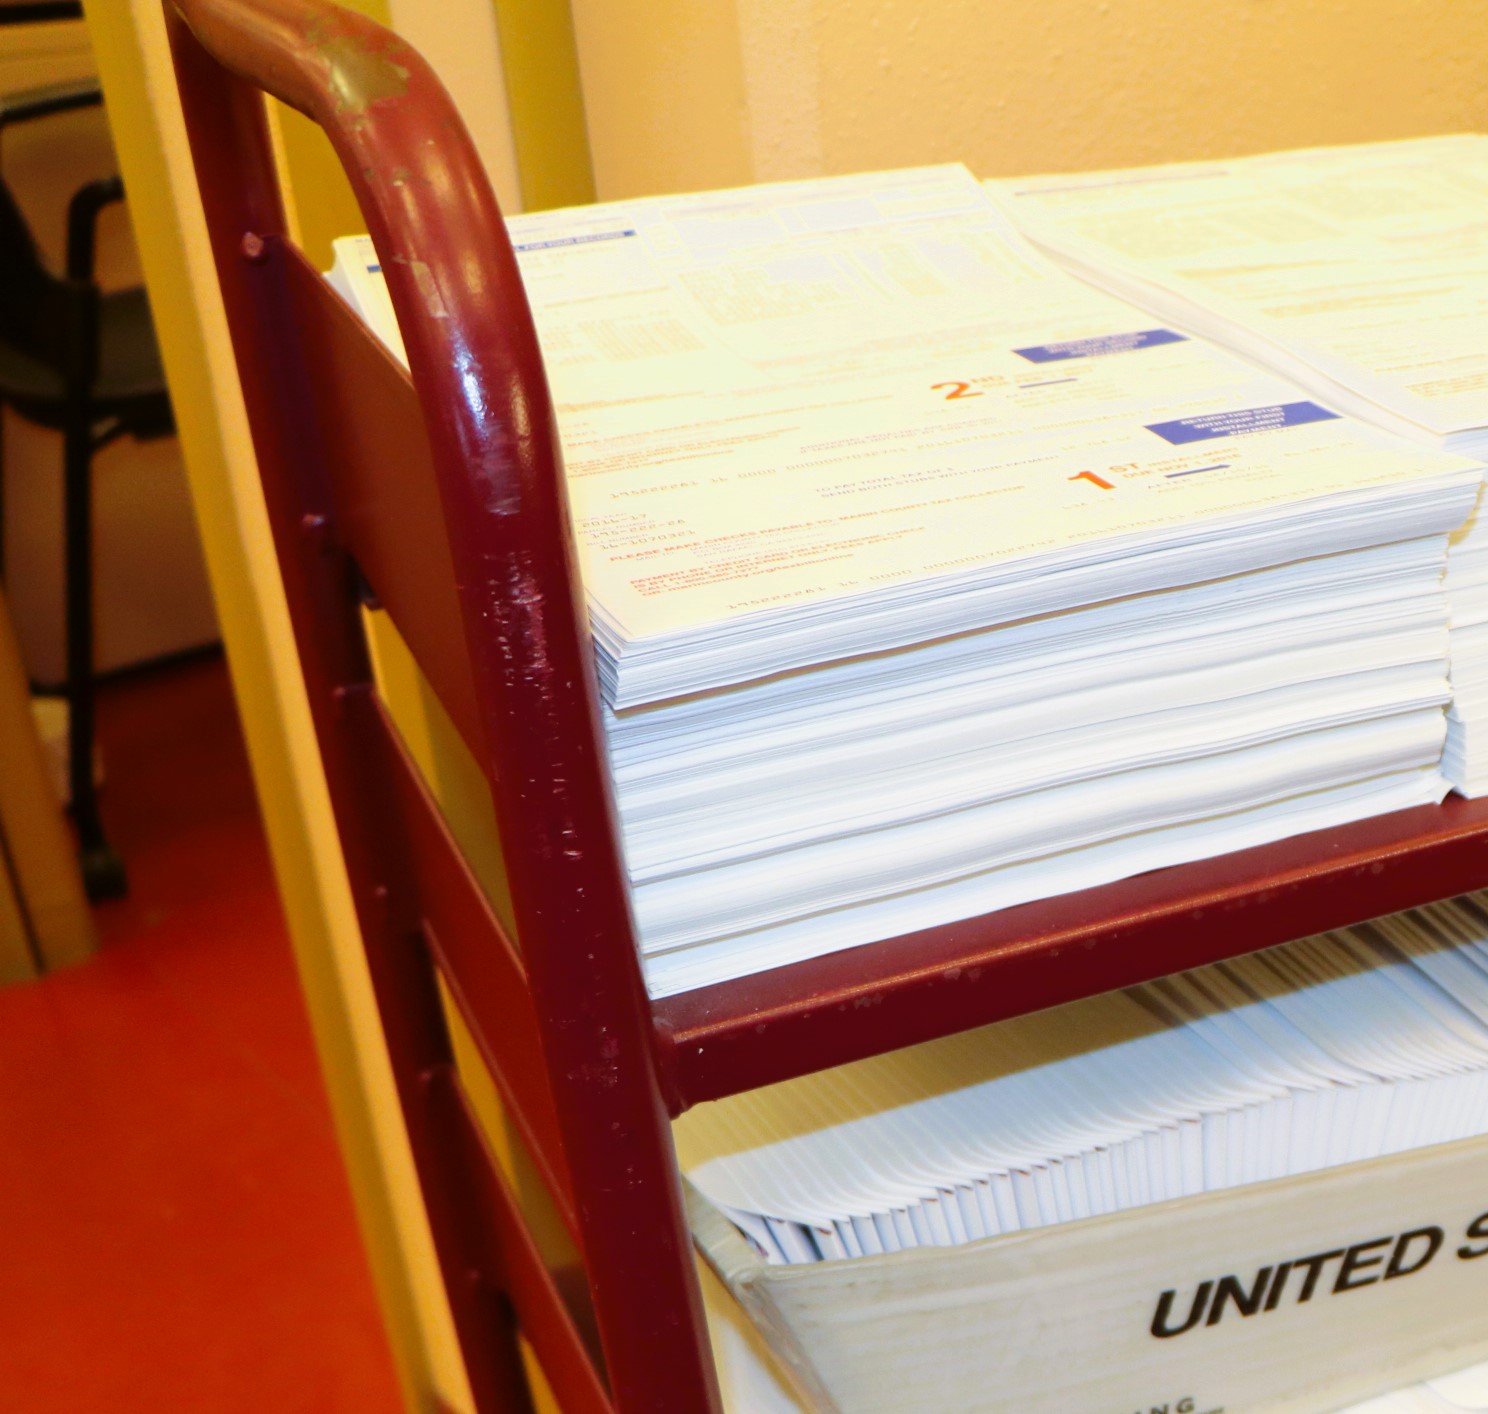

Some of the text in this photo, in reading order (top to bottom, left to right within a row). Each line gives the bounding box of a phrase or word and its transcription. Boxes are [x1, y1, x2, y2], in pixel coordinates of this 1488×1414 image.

[610, 549, 661, 562] PLEASE
[664, 541, 701, 551] MAKE
[703, 530, 757, 544] CHECKS
[759, 521, 813, 535] PAYABLE
[630, 570, 685, 585] PAYMENT
[708, 558, 752, 569] CREDIT
[754, 551, 788, 560] CARD
[668, 571, 711, 582] PHONE
[1151, 1225, 1445, 1339] UNITED
